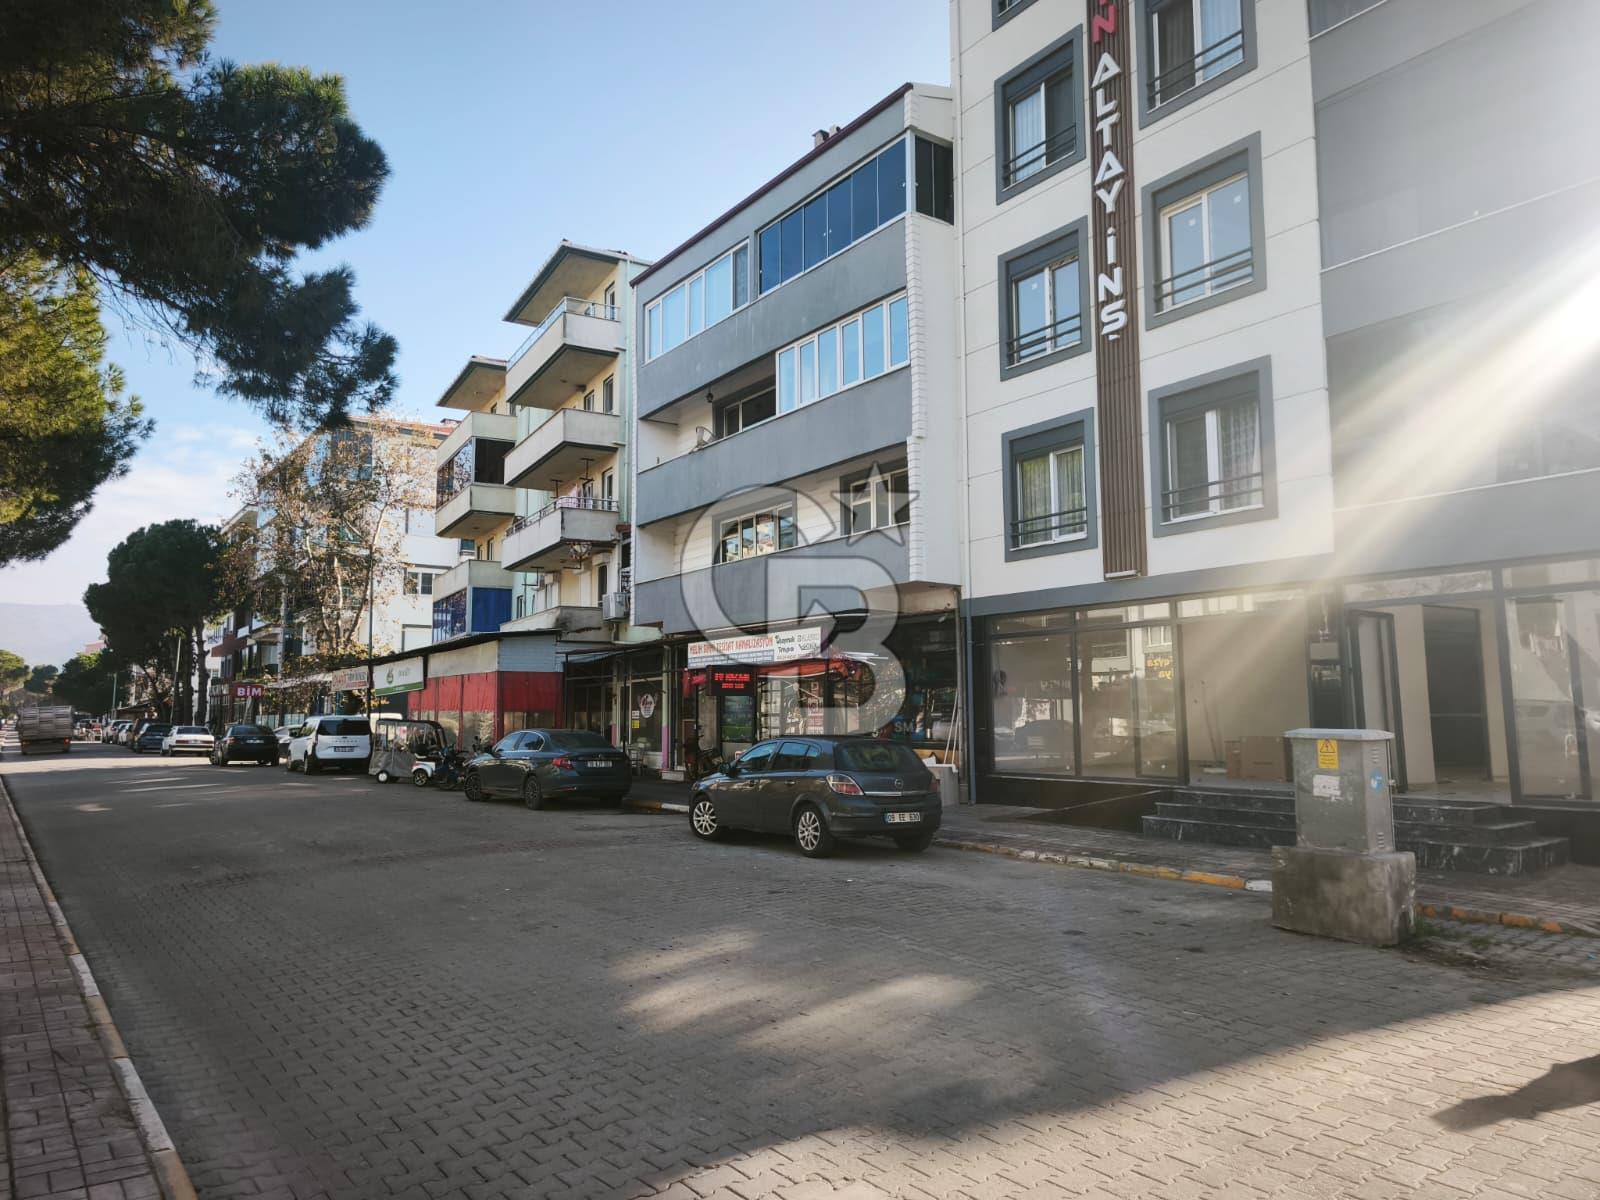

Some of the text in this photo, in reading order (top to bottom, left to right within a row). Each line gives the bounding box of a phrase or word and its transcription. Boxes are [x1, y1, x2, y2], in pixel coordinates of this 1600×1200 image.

[1091, 51, 1126, 214] ALTAY
[1097, 226, 1128, 341] İNŞ
[237, 686, 262, 697] BİM
